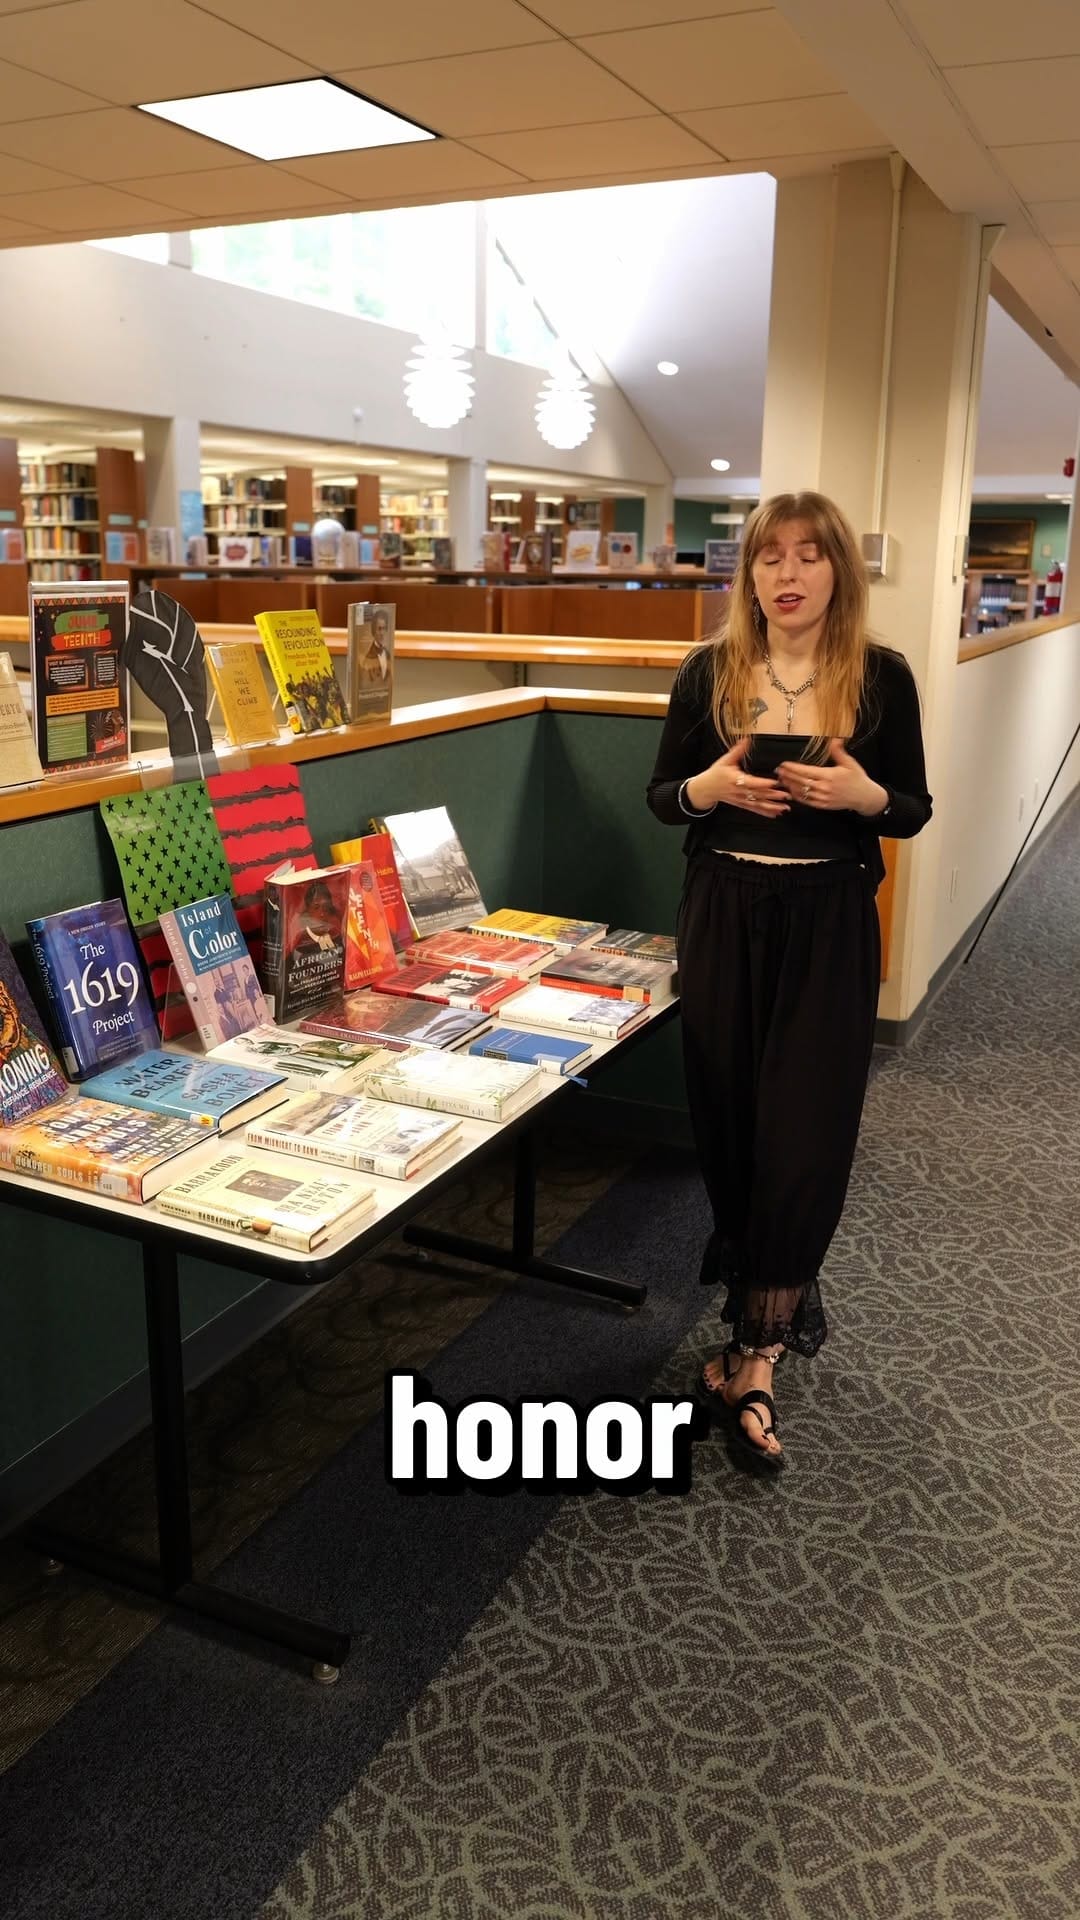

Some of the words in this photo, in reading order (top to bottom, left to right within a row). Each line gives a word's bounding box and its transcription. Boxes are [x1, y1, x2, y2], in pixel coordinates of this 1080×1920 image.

[64, 632, 100, 647] TEENTH
[275, 626, 317, 638] RESOUNDING
[284, 638, 326, 650] REVOLUTION
[237, 697, 258, 706] CLIMB
[239, 687, 251, 695] WE
[180, 901, 222, 928] Island
[80, 943, 106, 960] The
[188, 928, 238, 960] Color
[33, 943, 46, 965] 1619
[42, 966, 55, 999] Project
[288, 957, 343, 983] FOUNDERS
[292, 949, 340, 970] AFRICAN
[63, 961, 139, 1014] 1619
[92, 1011, 135, 1035] Project
[115, 1058, 181, 1087] WATER
[130, 1059, 210, 1099] BEARERS
[181, 1072, 241, 1101] SASHA
[40, 1109, 91, 1134] FOUR
[47, 1107, 134, 1149] HUNDRED
[84, 1120, 147, 1149] SOULS
[247, 1132, 263, 1144] FROM
[264, 1134, 293, 1151] MIDNIGHT
[294, 1143, 301, 1153] TO
[15, 1155, 53, 1174] HUNDRED
[56, 1165, 83, 1183] SOULS
[174, 1153, 243, 1195] BARRACOON
[294, 1183, 352, 1216] URSTON
[296, 1178, 330, 1200] NEAL
